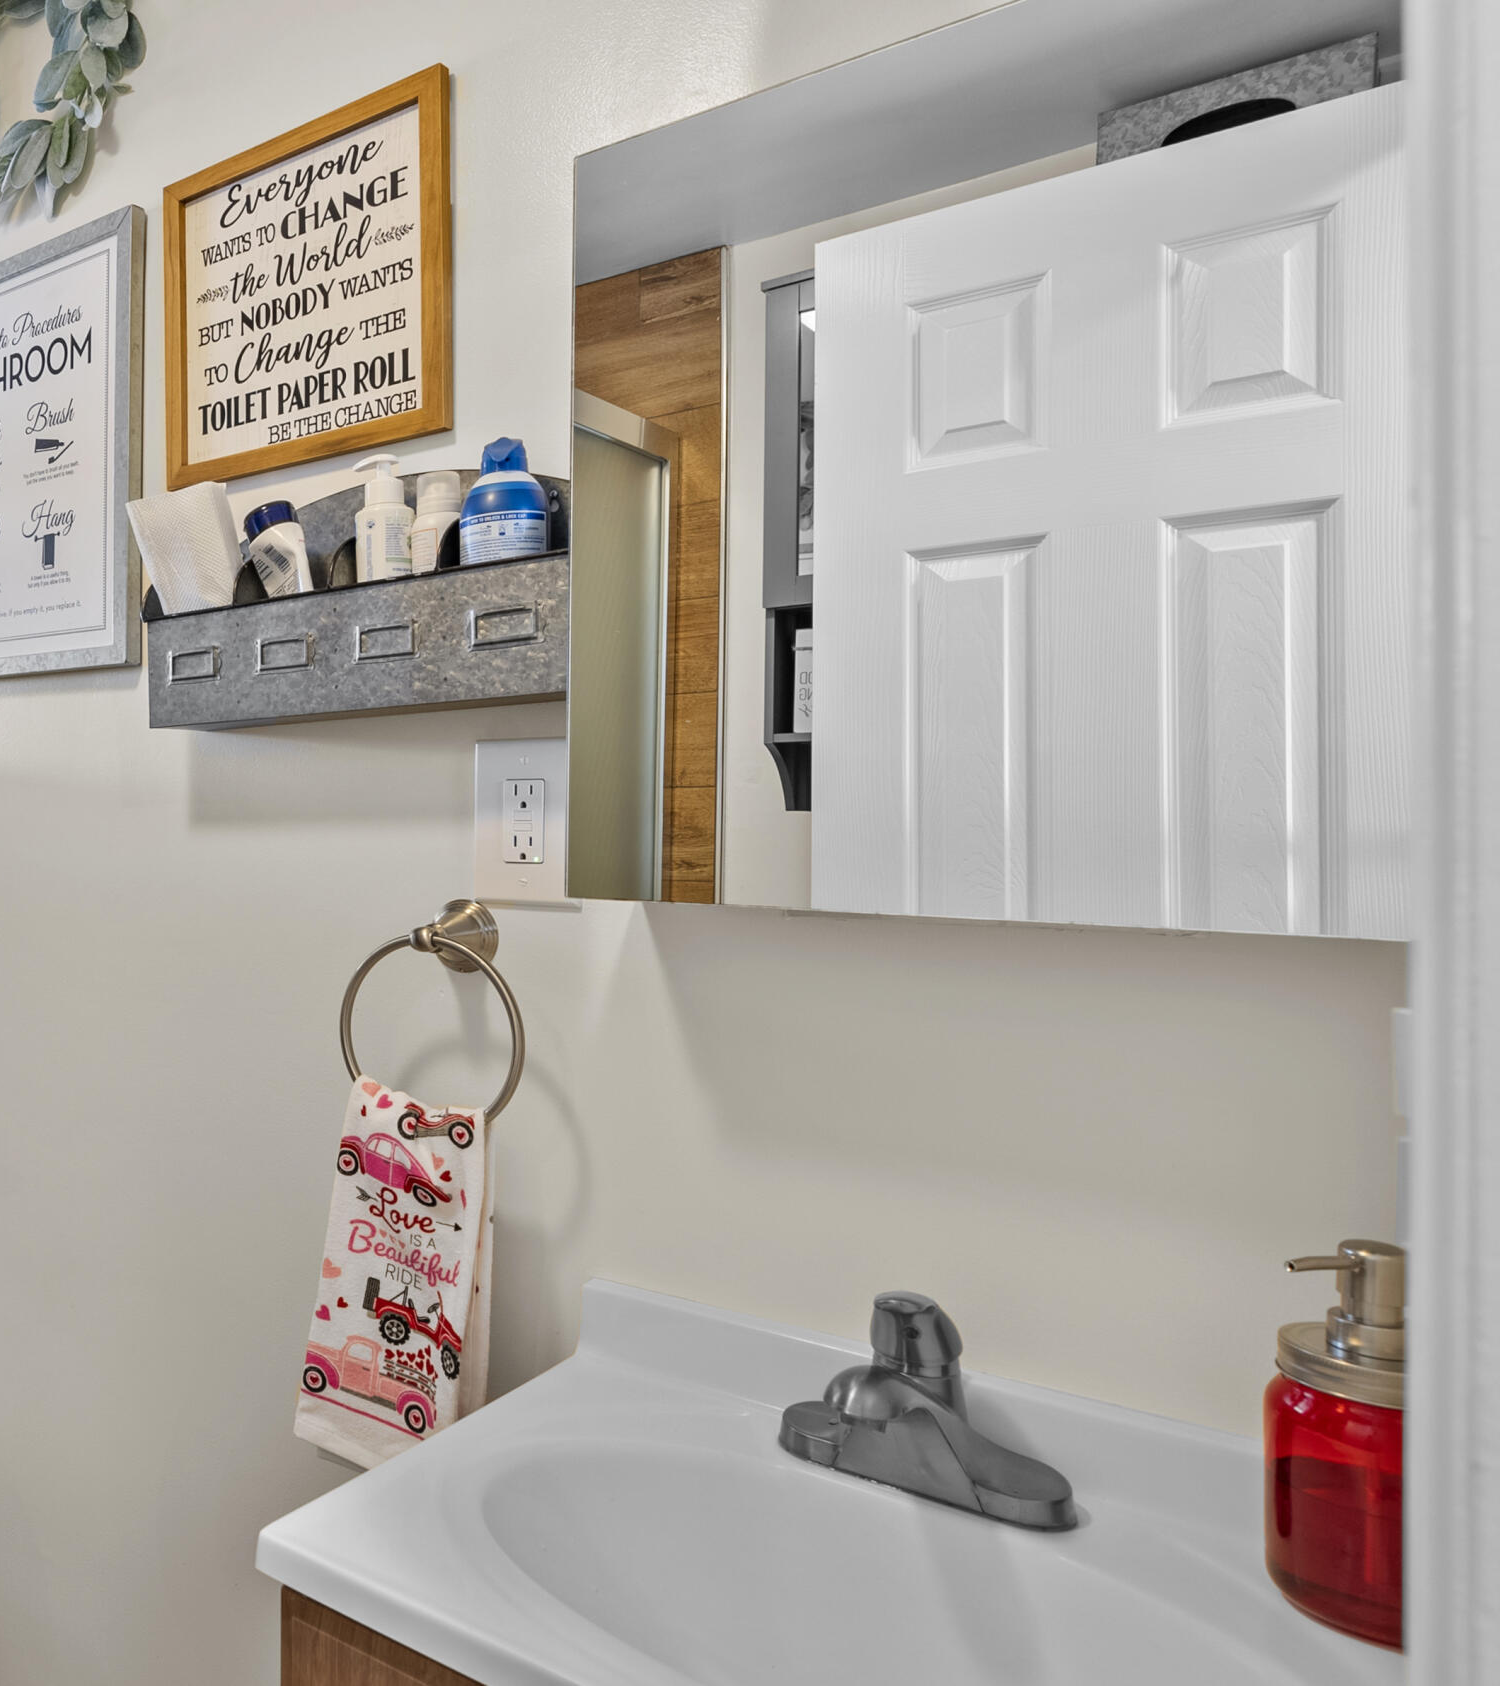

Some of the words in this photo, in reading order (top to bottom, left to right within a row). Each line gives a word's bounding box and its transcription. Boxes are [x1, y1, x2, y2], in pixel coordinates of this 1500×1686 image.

[220, 139, 384, 229] Everyone
[201, 231, 252, 267] WANTS
[257, 222, 276, 245] TO
[281, 166, 409, 240] CHANGE
[230, 262, 269, 303] the
[274, 215, 375, 286] World
[12, 304, 84, 346] Procedures
[198, 319, 233, 347] BUT
[240, 279, 336, 336] NOBODY
[340, 257, 414, 301] WANTS
[204, 362, 229, 386] TO
[235, 322, 356, 385] Change
[360, 308, 406, 341] THE
[25, 398, 75, 435] Brush
[199, 386, 271, 435] TOILET
[277, 367, 346, 416] PAPER
[354, 348, 415, 395] ROLL
[267, 424, 292, 445] BE
[294, 411, 331, 437] THE
[335, 390, 417, 429] CHANGE
[21, 499, 76, 538] Hang
[369, 1186, 436, 1234] Love
[347, 1219, 461, 1287] Beautiful
[409, 1233, 424, 1247] IS
[426, 1237, 436, 1250] A
[384, 1263, 423, 1291] RIDE
